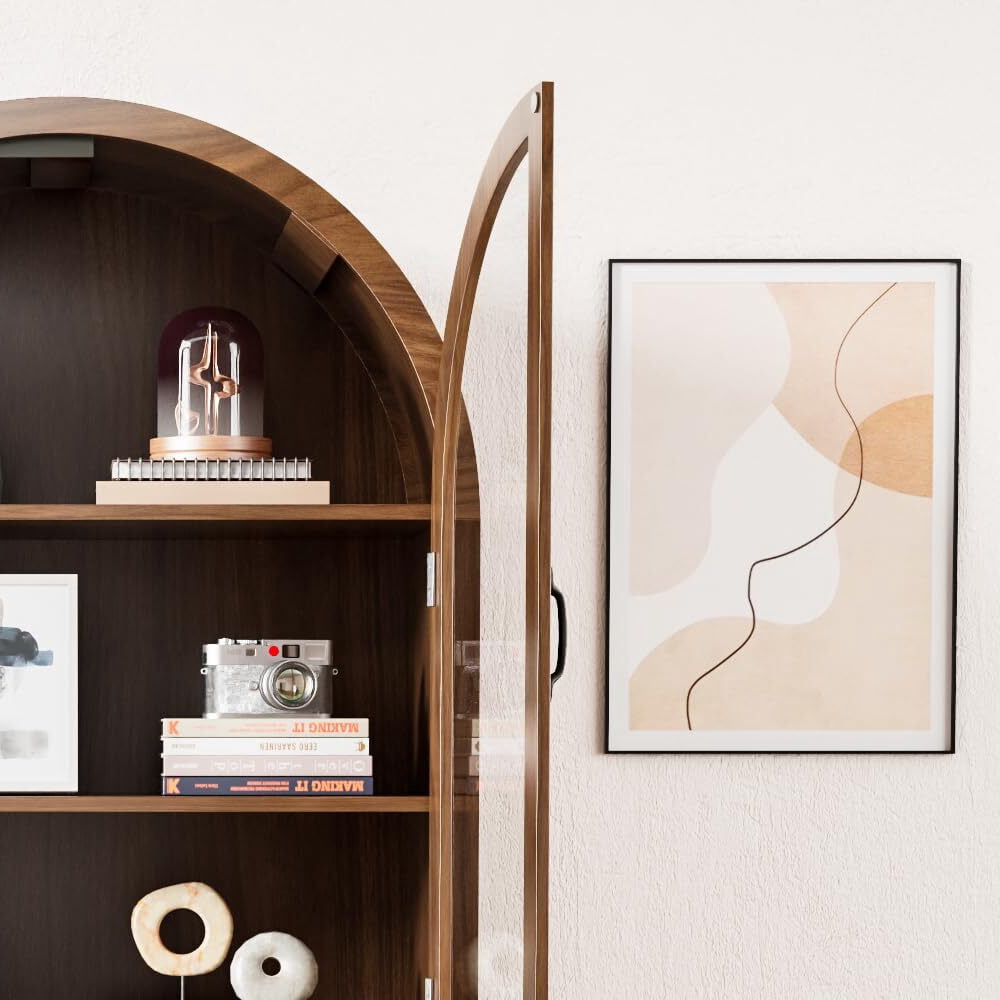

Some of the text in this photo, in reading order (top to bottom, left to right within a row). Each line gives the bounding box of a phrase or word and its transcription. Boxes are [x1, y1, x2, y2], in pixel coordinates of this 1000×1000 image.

[291, 722, 306, 733] IT
[309, 722, 360, 733] MAKING
[259, 743, 297, 752] SAARINEN
[294, 780, 309, 792] IT
[311, 780, 364, 792] MAKING
